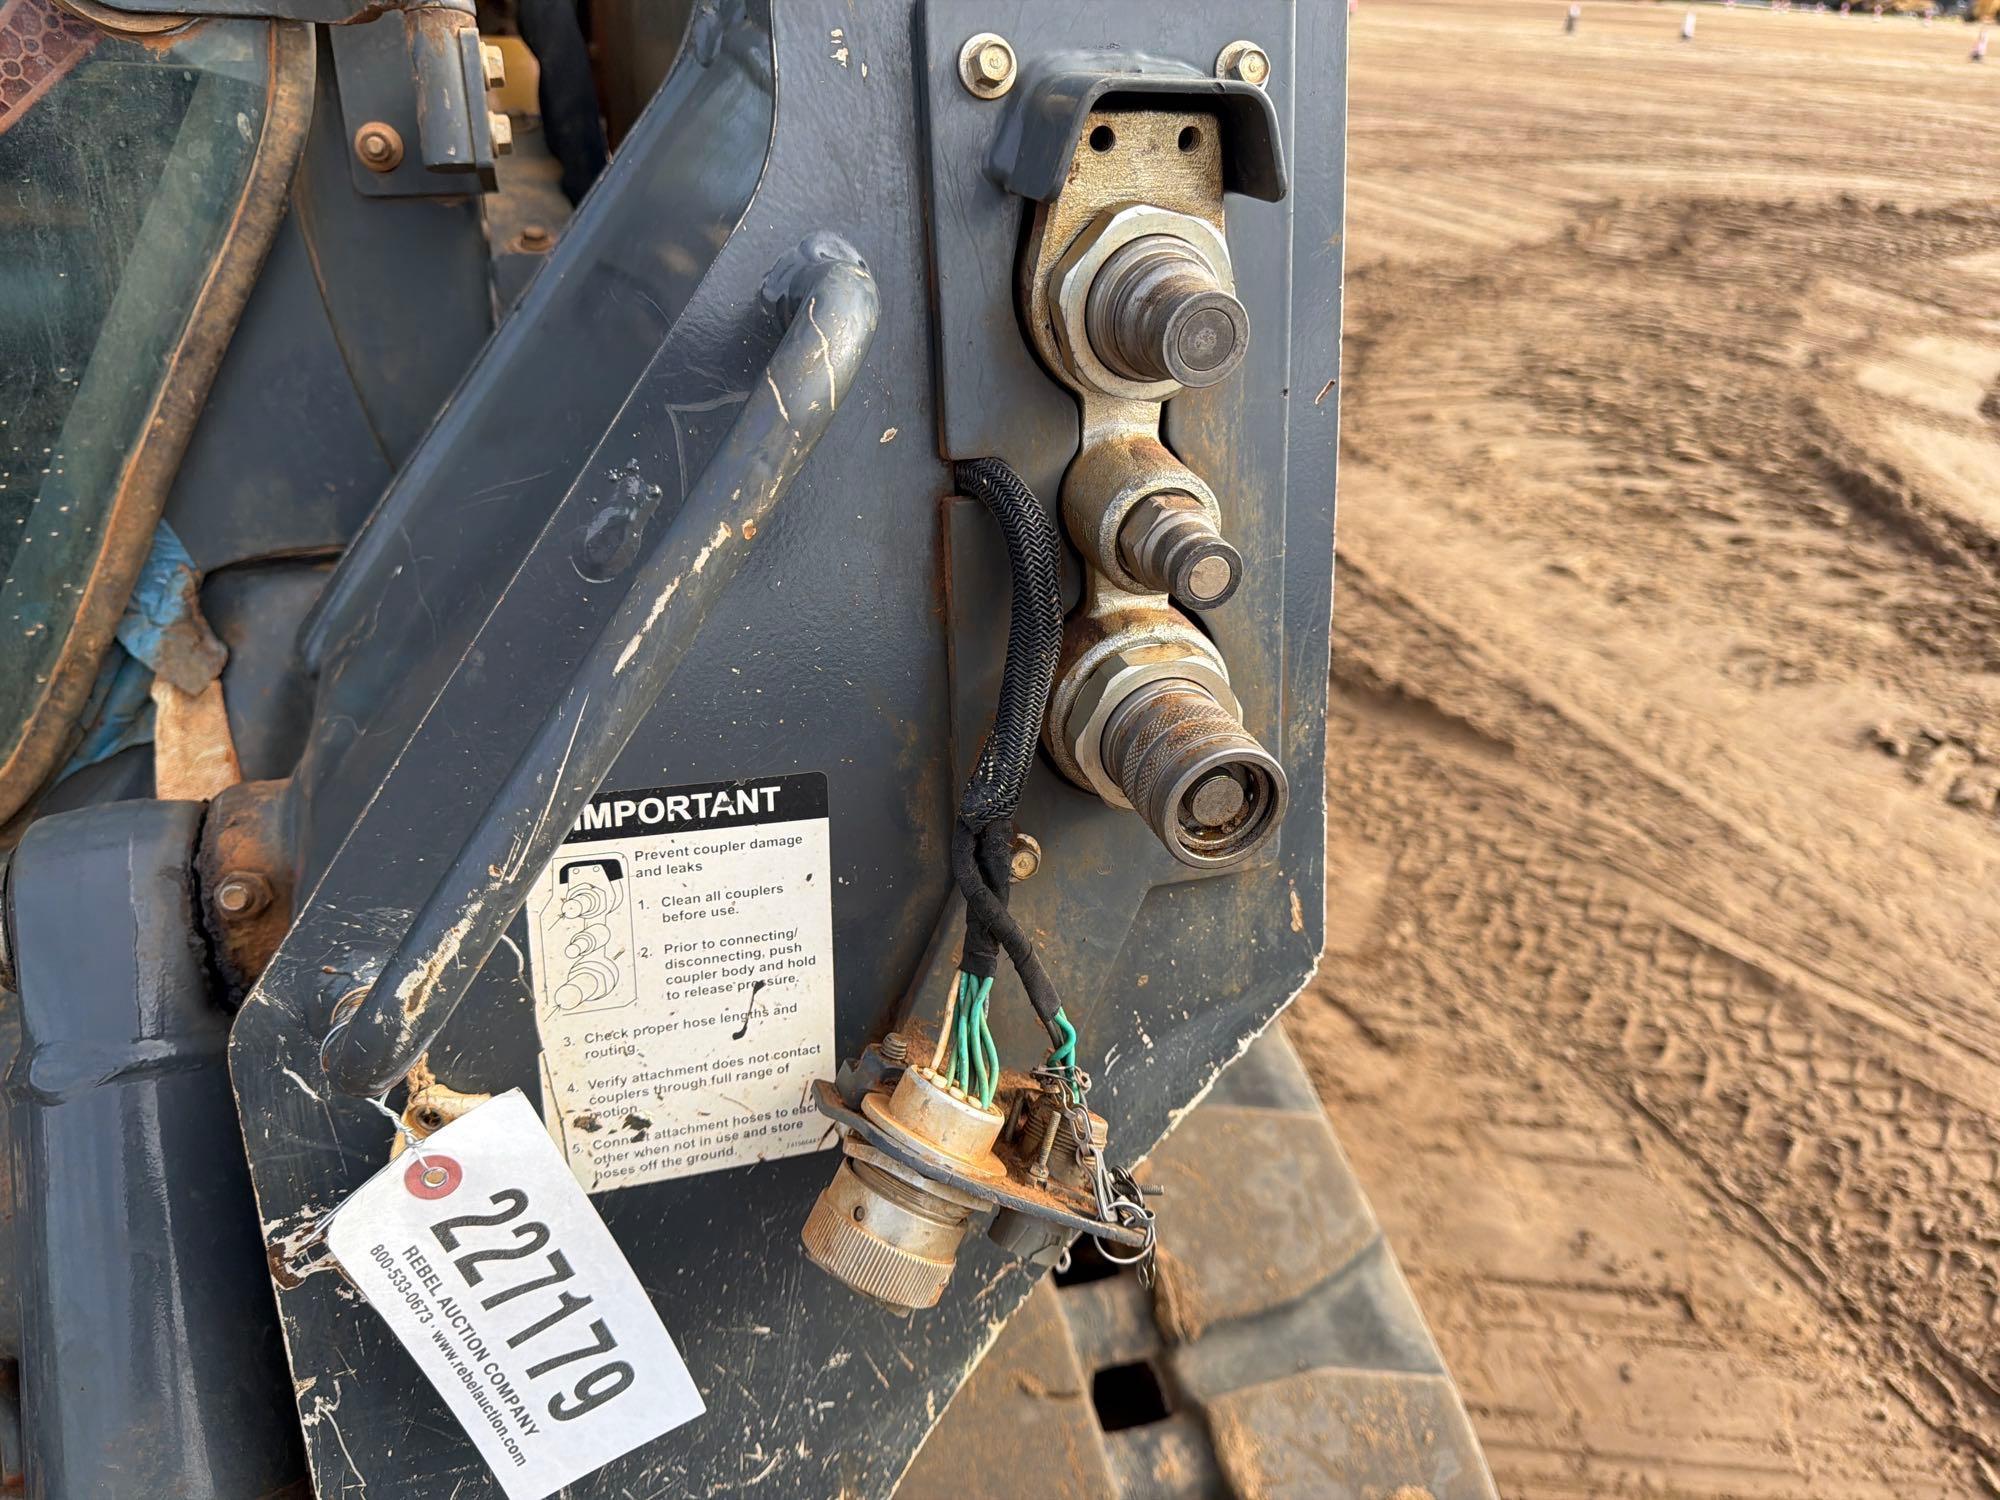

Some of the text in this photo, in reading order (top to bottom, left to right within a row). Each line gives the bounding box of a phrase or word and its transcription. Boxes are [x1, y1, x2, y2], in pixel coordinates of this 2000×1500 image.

[635, 835, 803, 861] Prevent coupler damage
[635, 862, 703, 878] and leaks
[638, 884, 784, 910] 1. Clean all couplers
[662, 906, 739, 923] before use.
[640, 927, 798, 959] 2. Prior to connecting/
[665, 942, 802, 970] disconnecting, push
[666, 955, 816, 985] coupler body and hold
[667, 991, 680, 1001] to
[684, 983, 733, 998] release
[563, 1003, 798, 1047] 3. Check proper hose lengths and
[567, 1044, 821, 1093] 4. Verify attachment does not contact
[585, 1044, 640, 1060] routing.
[589, 1063, 790, 1105] couplers through full range of
[593, 1131, 650, 1150] Connt
[654, 1118, 728, 1140] attachment
[733, 1110, 772, 1126] hoses
[775, 1108, 788, 1118] to
[594, 1120, 803, 1166] other when not in use and store
[594, 1147, 737, 1181] hoses off the ground.
[430, 1188, 636, 1422] 227179
[370, 1244, 527, 1467] 800-533-0673 www.rebelauction.com
[402, 1245, 540, 1436] REBEL AUCTION COMPANY
